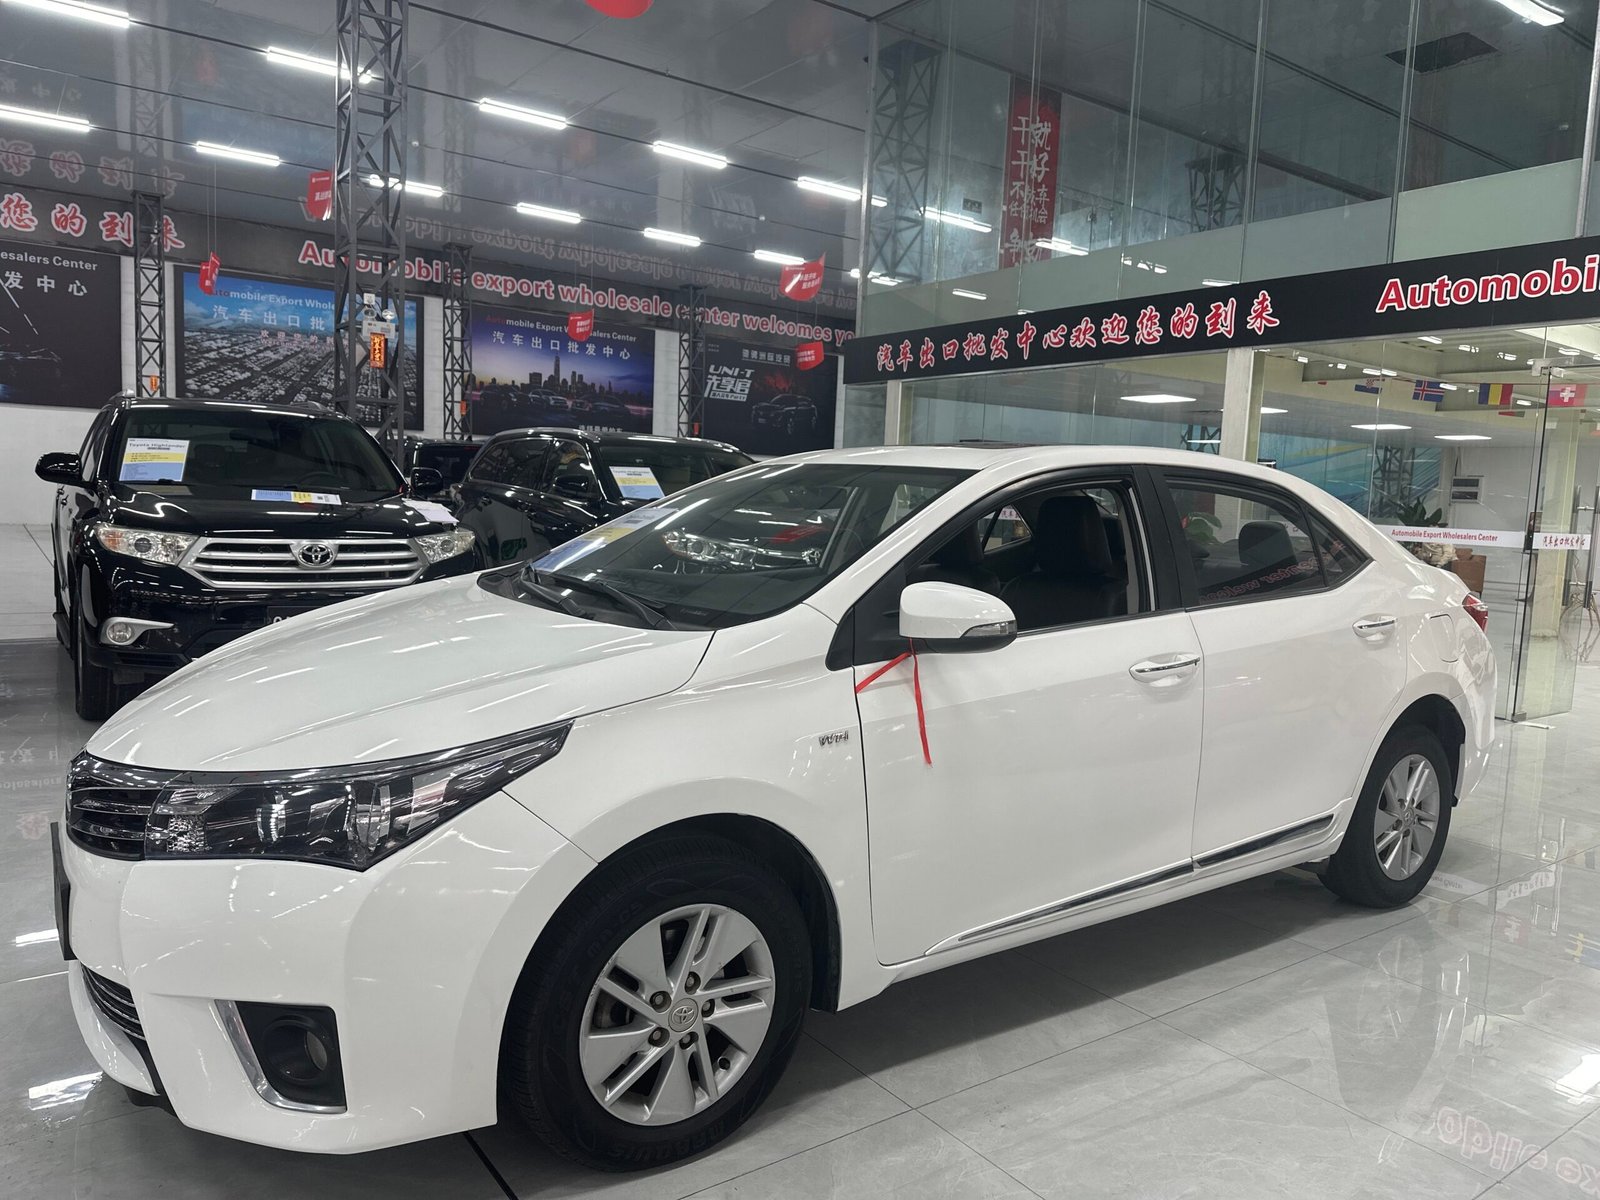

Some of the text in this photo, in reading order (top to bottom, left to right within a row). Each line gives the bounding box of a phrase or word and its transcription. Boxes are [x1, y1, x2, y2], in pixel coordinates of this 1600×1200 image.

[52, 256, 98, 272] Center
[4, 270, 88, 297] 发中心
[268, 295, 303, 306] Export
[472, 271, 555, 300] export
[558, 283, 673, 318] wholesale
[743, 313, 832, 342] welcomes
[535, 321, 563, 333] Export
[611, 331, 637, 343] Center
[876, 289, 1280, 373] 汽车出口批发中心欢迎您的到来
[492, 330, 631, 361] 汽车出口批发中心
[709, 364, 755, 378] UNI-T
[1391, 529, 1498, 541] Automobile Export Wholesalers Center
